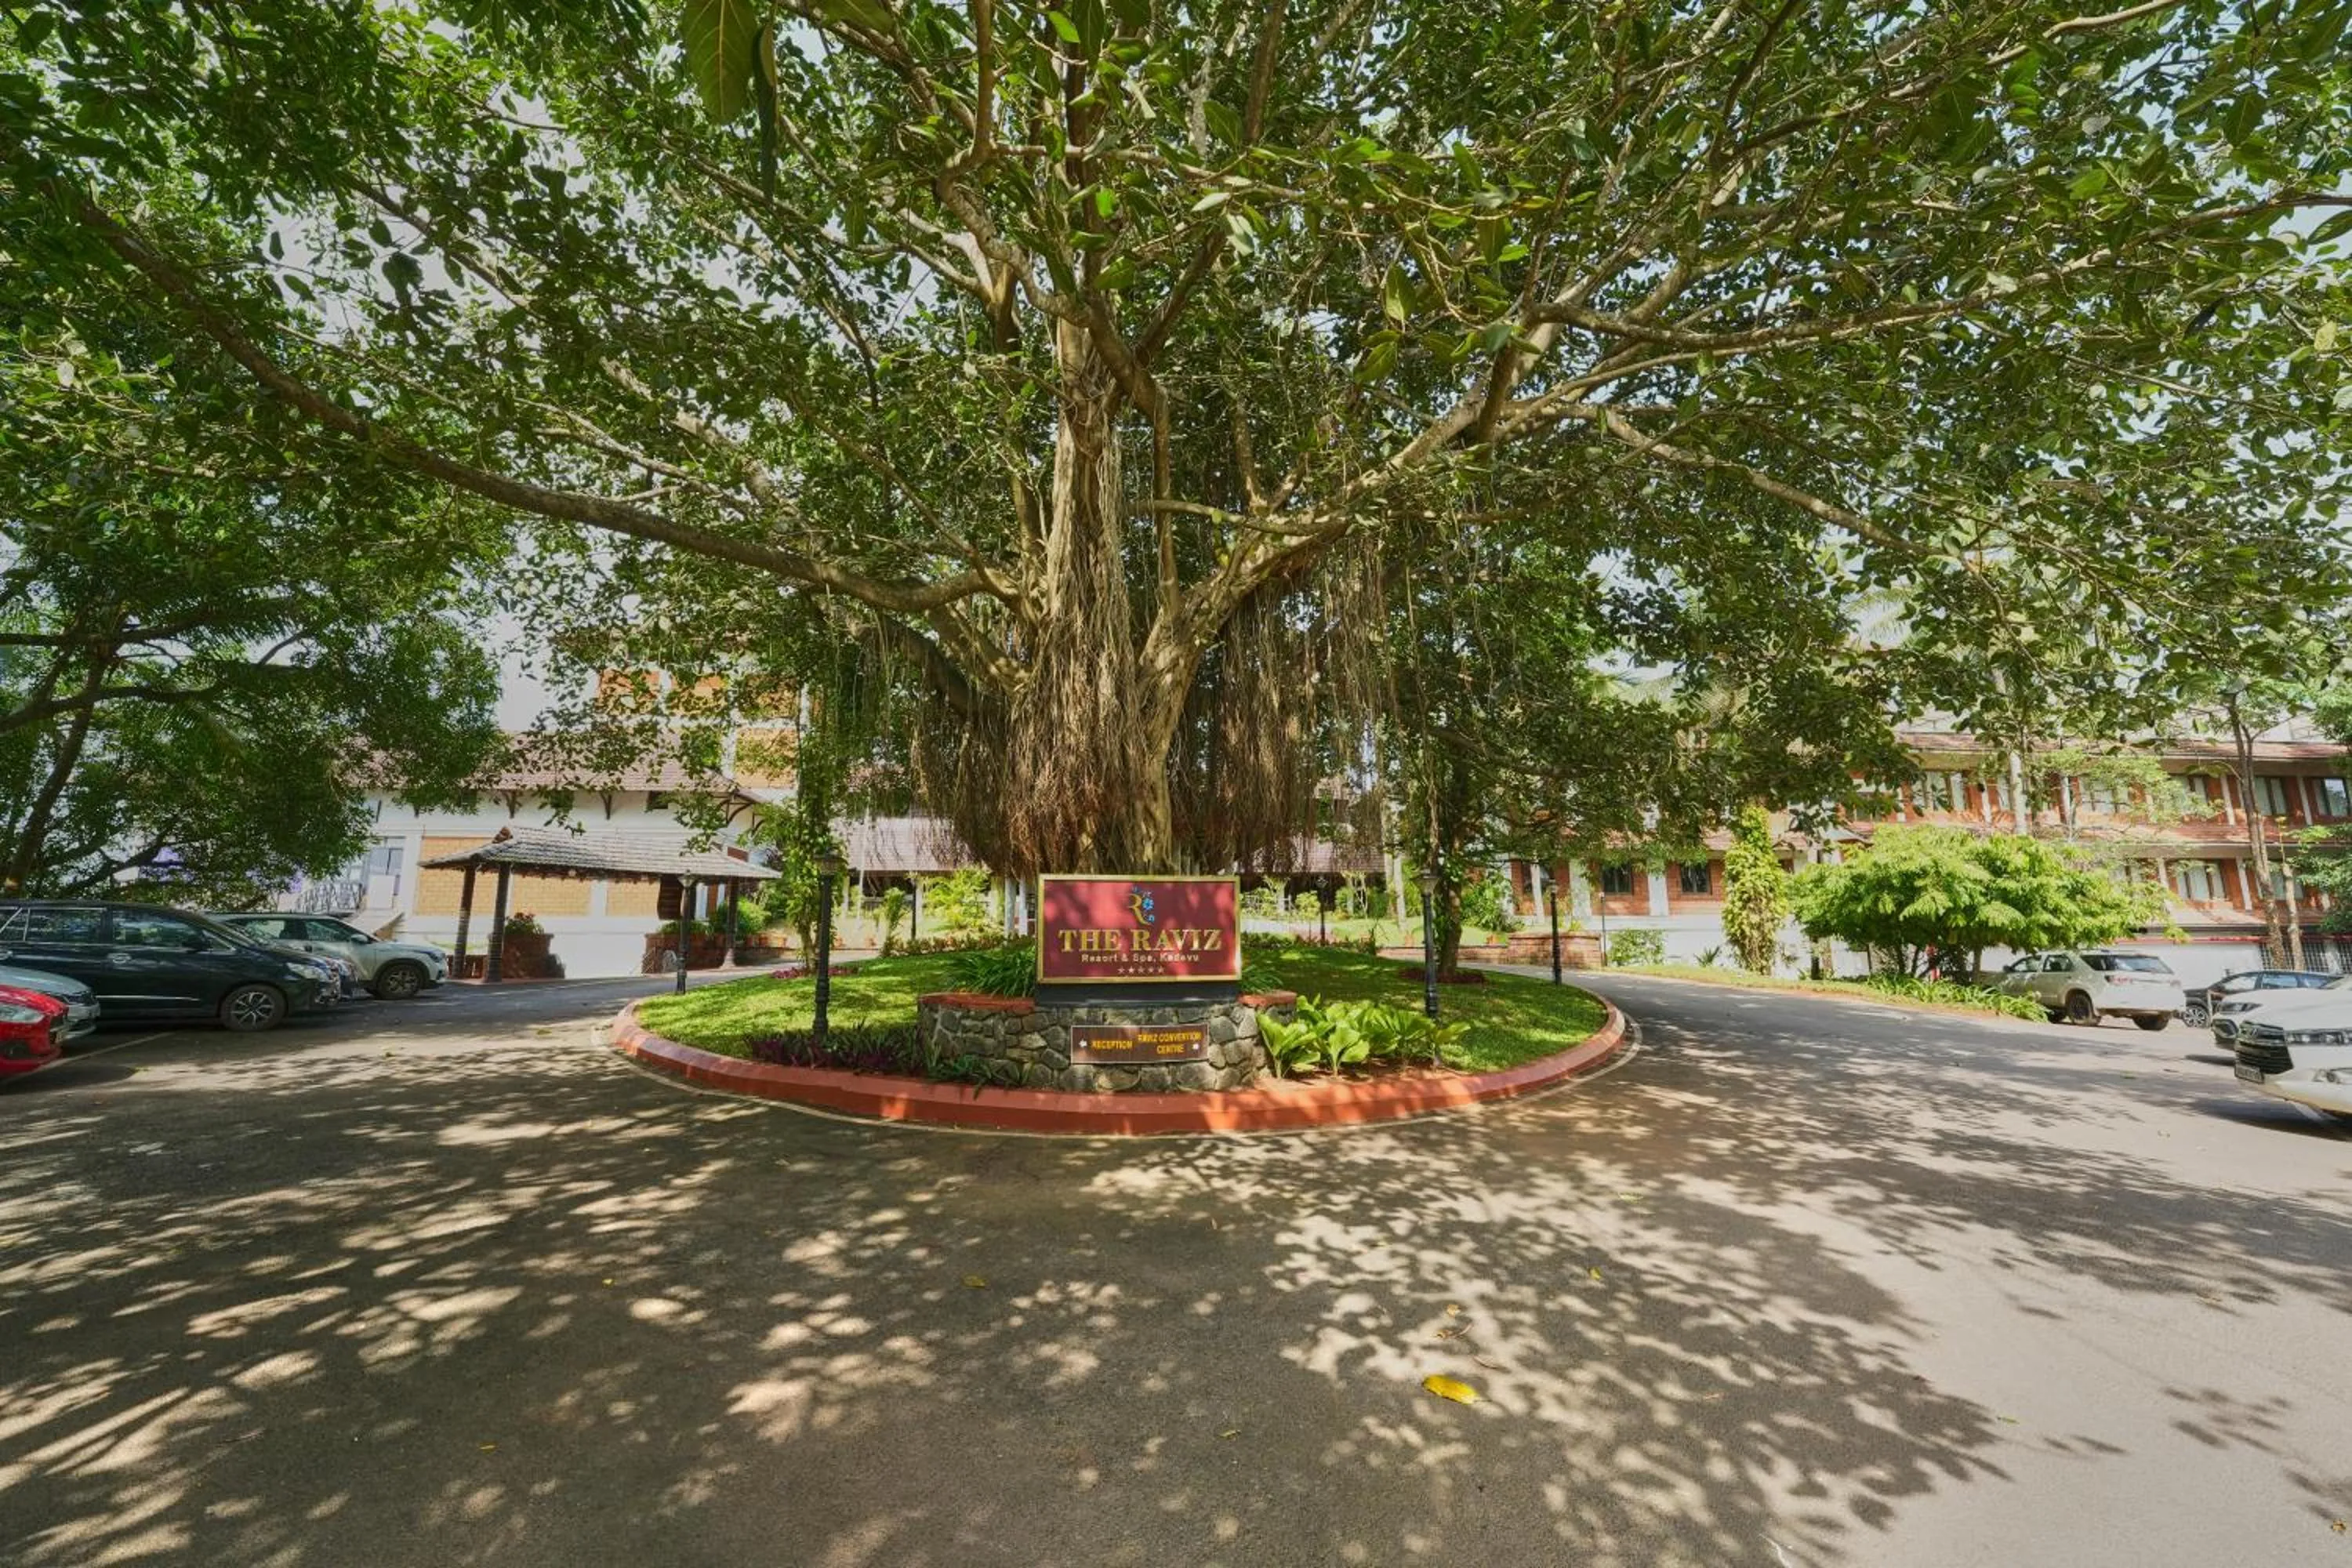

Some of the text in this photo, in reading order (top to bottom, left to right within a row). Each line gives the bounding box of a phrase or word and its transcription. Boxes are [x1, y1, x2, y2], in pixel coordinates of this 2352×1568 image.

[1058, 928, 1222, 952] THE RAVIZ
[1081, 954, 1117, 963] Resort
[1159, 1032, 1202, 1042] CONVENTION
[1091, 1040, 1133, 1051] RECEPTION
[1156, 1044, 1185, 1054] CENTRE
